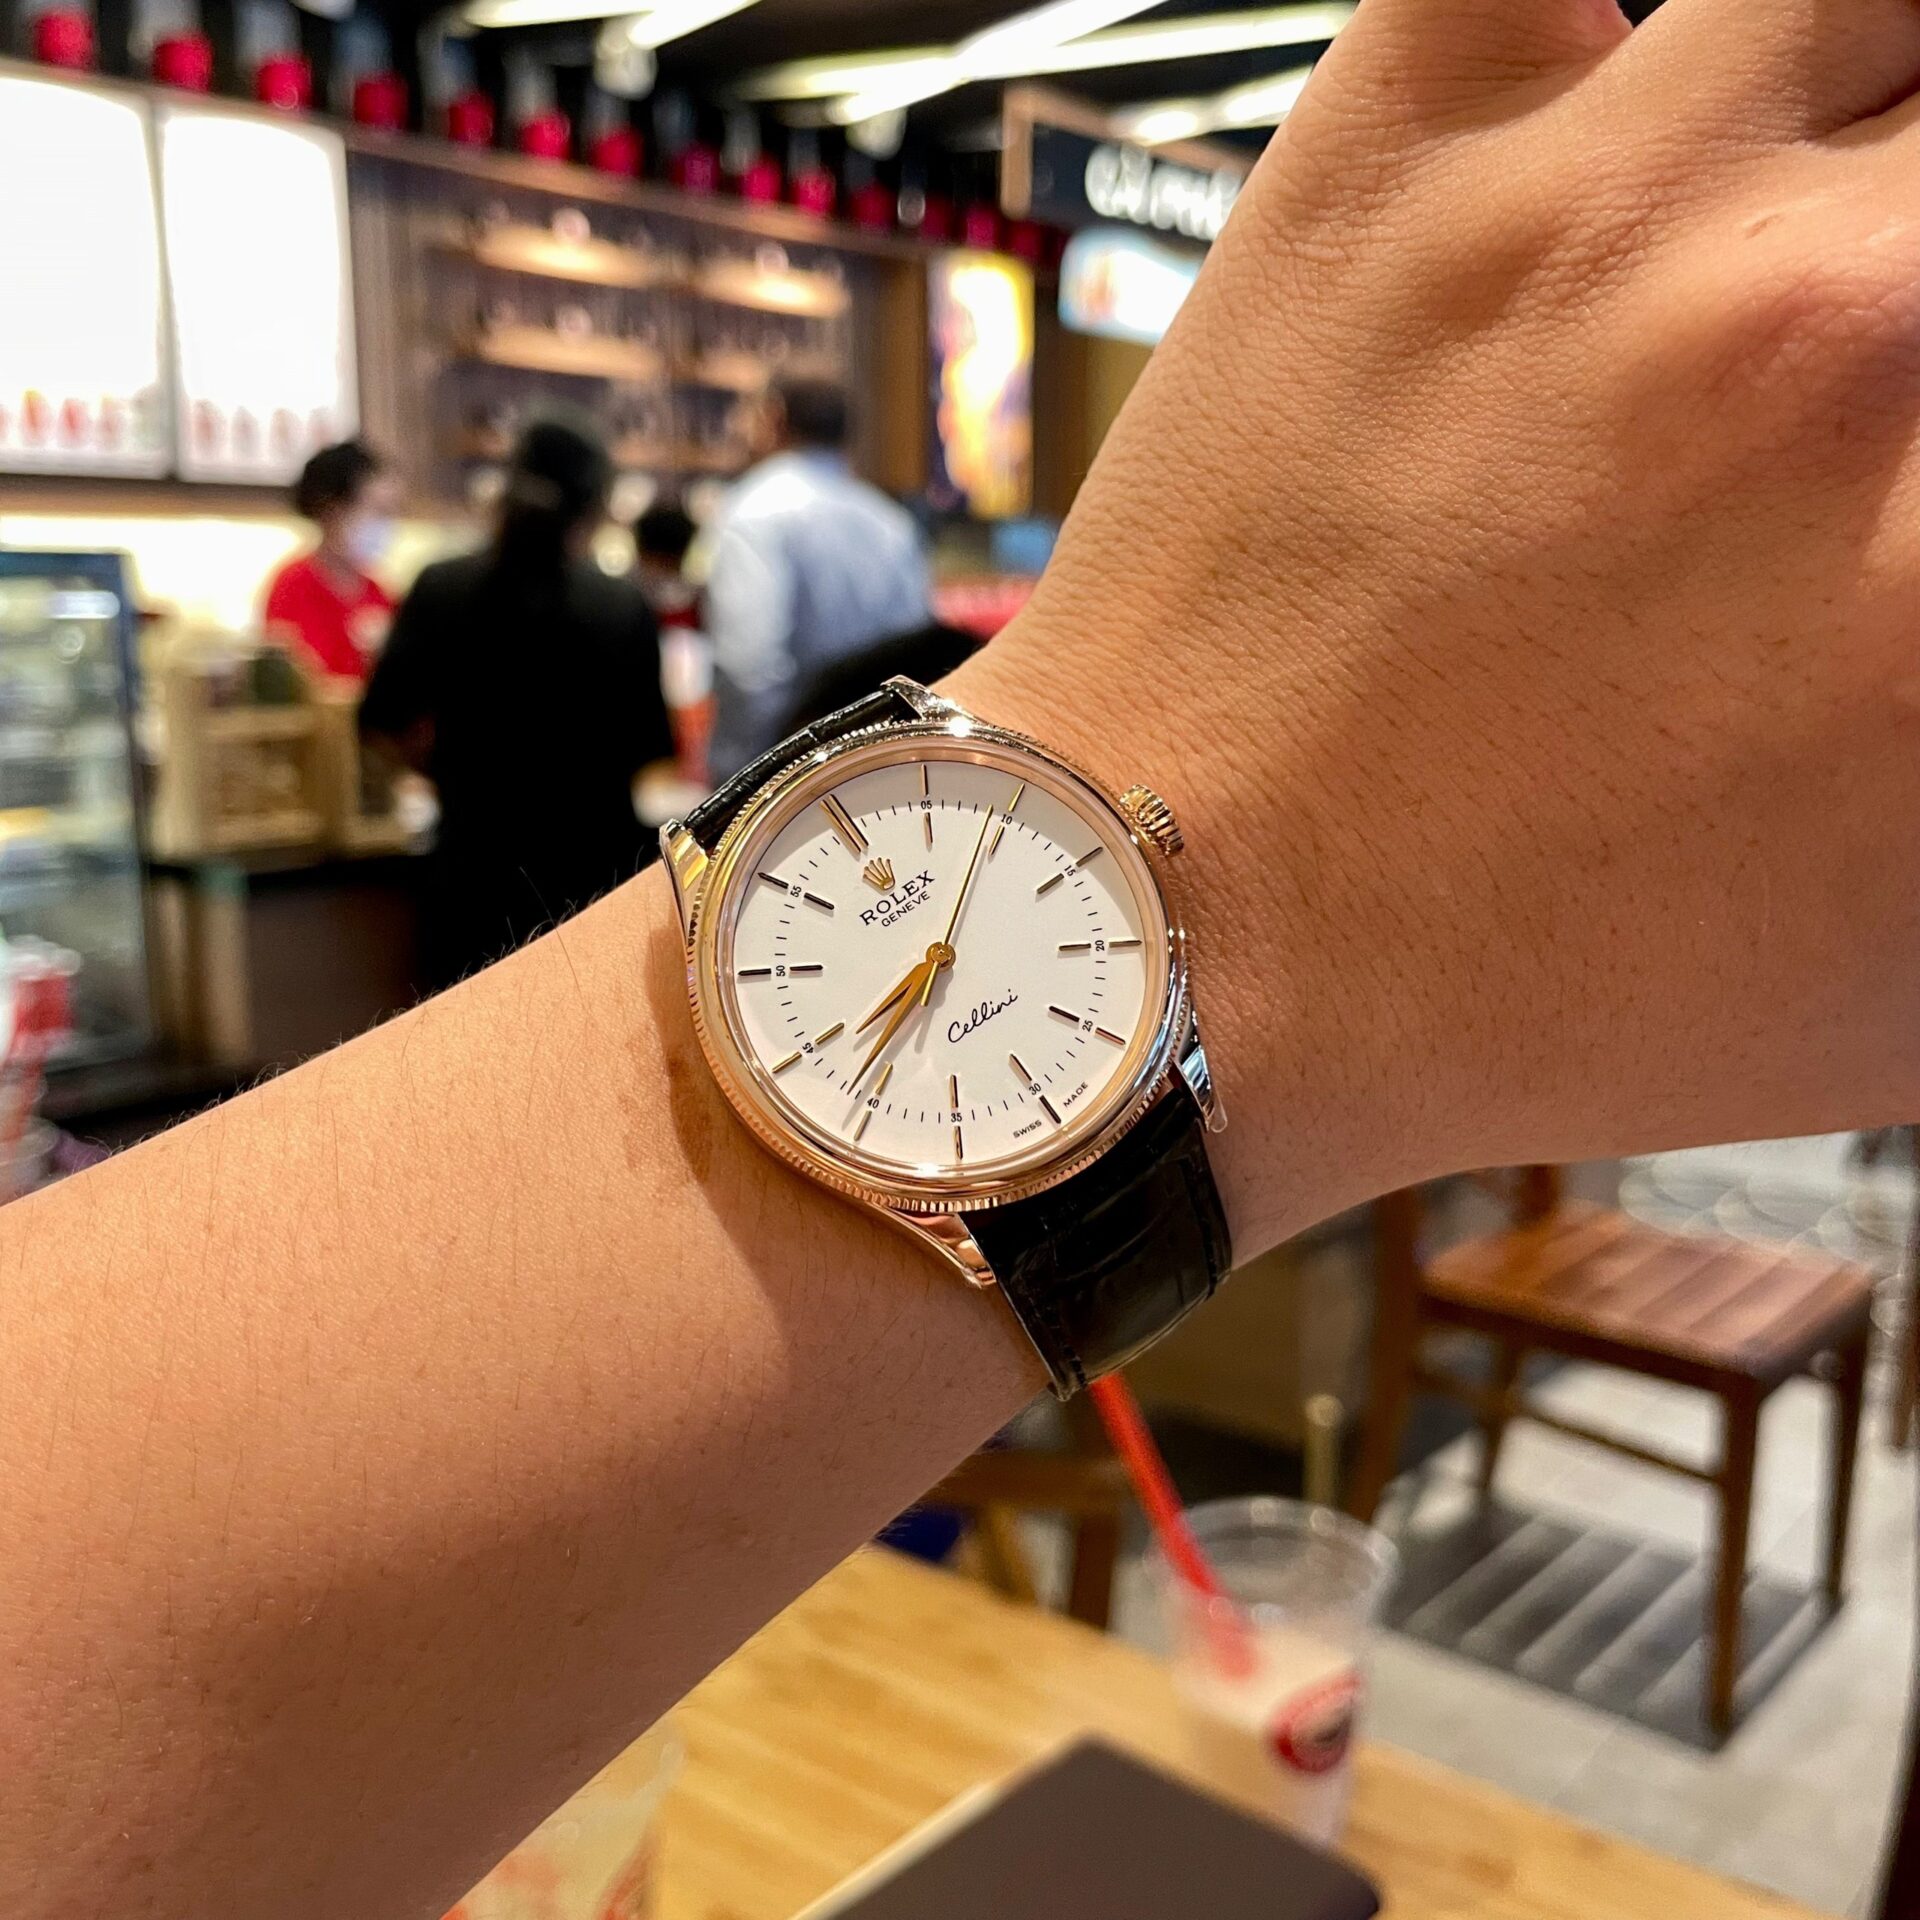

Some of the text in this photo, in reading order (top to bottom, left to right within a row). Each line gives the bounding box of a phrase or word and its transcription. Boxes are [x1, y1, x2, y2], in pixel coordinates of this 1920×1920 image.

[920, 800, 933, 810] 05
[1000, 813, 1013, 825] 10
[1063, 865, 1076, 877] 15
[790, 885, 802, 898] 55
[859, 869, 936, 926] ROLEX
[881, 890, 931, 927] GENEVE
[1094, 939, 1105, 952] 20
[775, 964, 786, 977] 50
[948, 988, 1019, 1043] Cellini
[1081, 1019, 1094, 1032] 25
[802, 1041, 815, 1054] 45
[1028, 1082, 1042, 1096] 30
[867, 1097, 880, 1109] 40
[1012, 1081, 1089, 1139] SWISS MADE
[950, 1112, 963, 1123] 35
